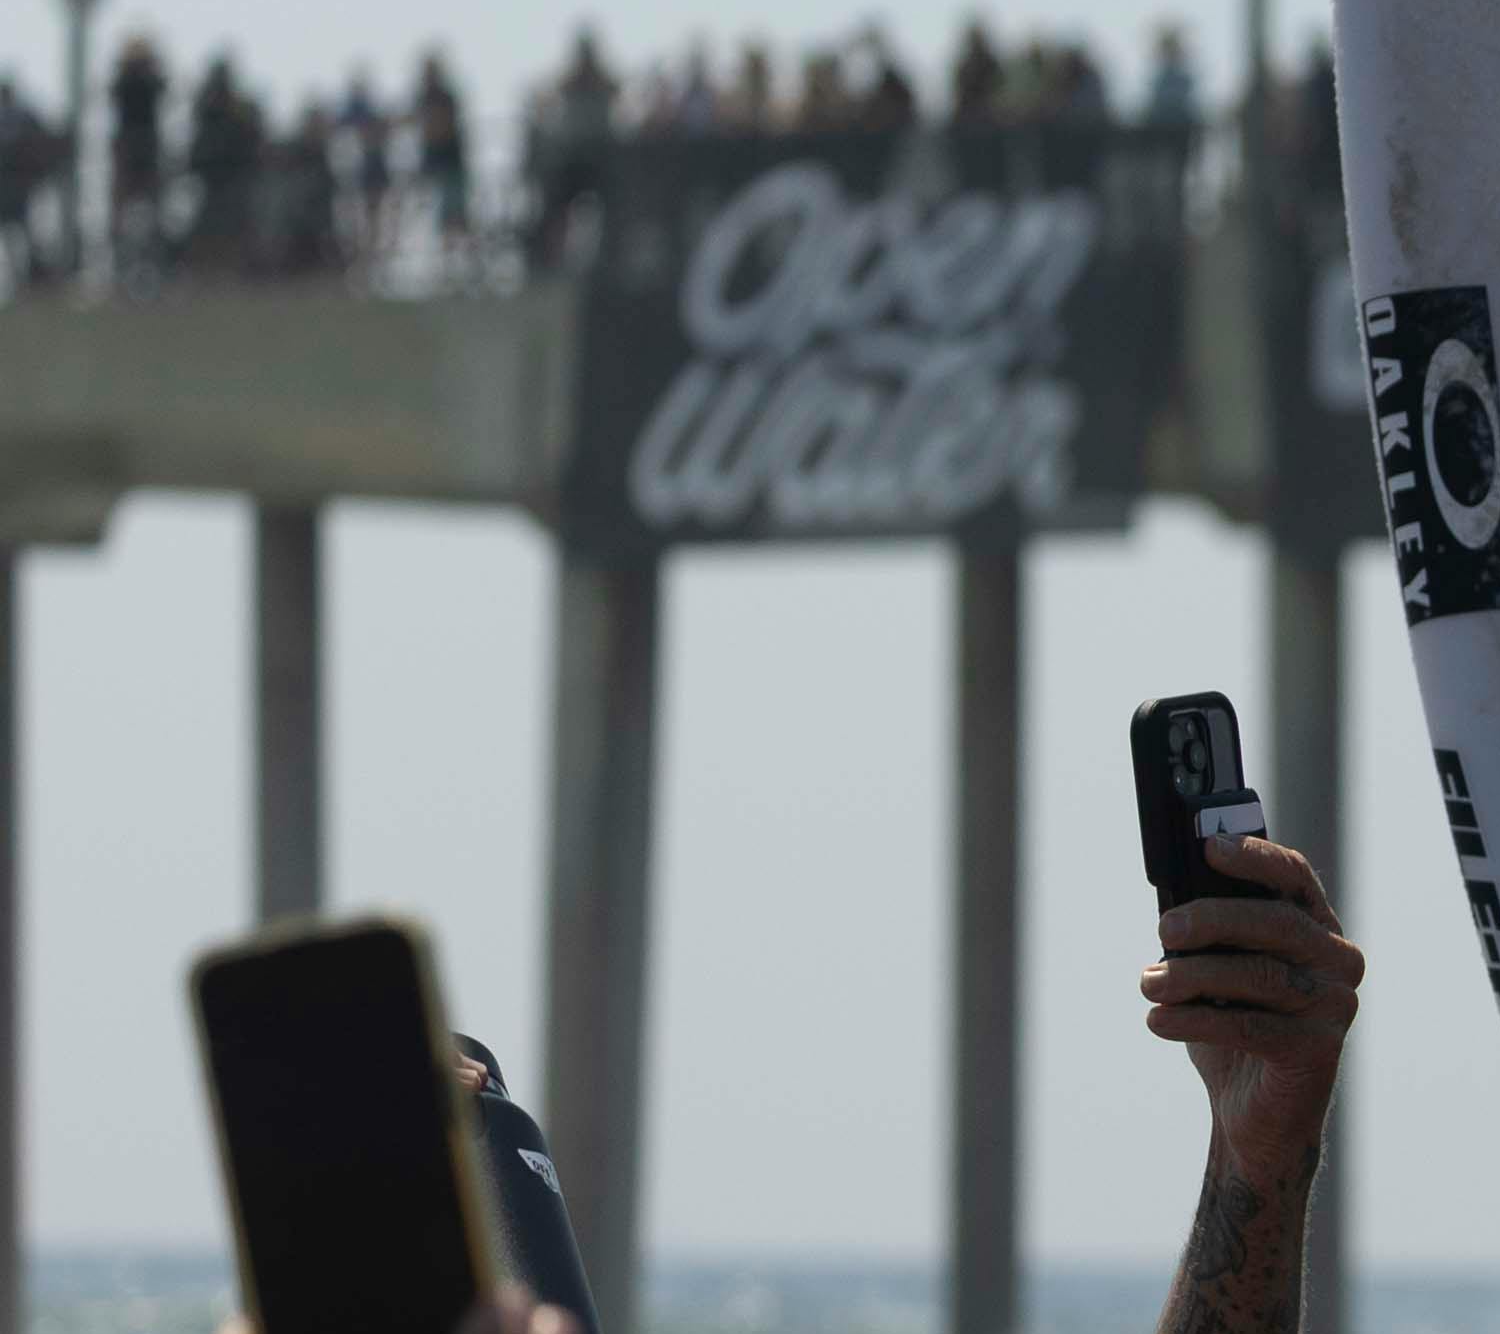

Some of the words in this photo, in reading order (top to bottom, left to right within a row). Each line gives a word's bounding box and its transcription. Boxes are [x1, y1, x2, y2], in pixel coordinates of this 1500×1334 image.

[681, 159, 1102, 361] Open
[628, 335, 1082, 531] Water
[1364, 296, 1432, 618] OAKLEY
